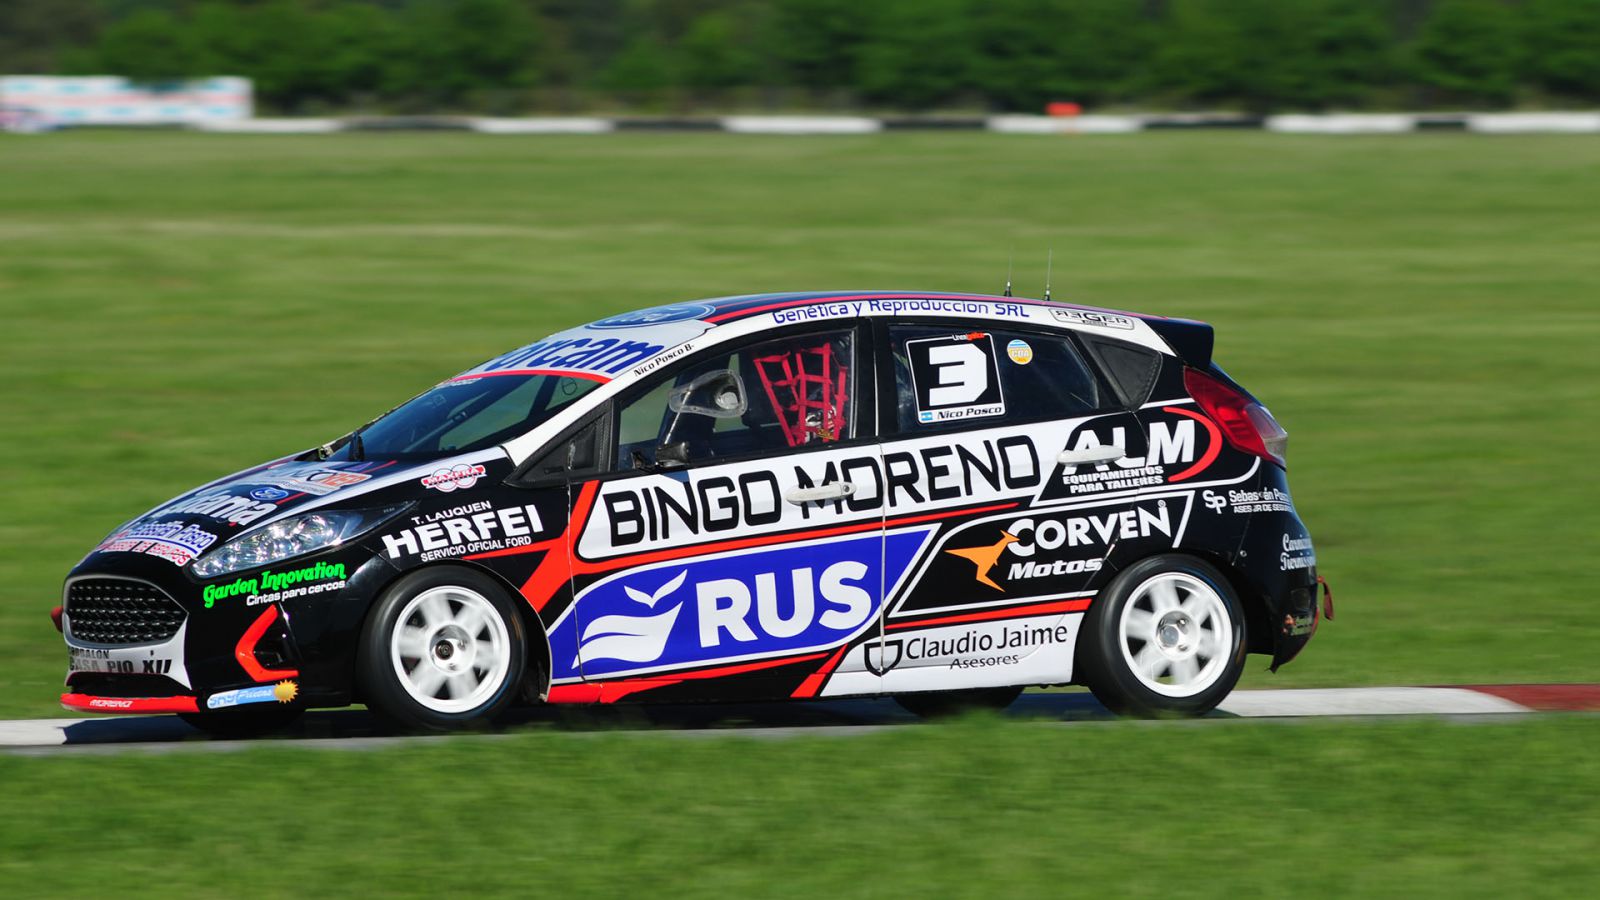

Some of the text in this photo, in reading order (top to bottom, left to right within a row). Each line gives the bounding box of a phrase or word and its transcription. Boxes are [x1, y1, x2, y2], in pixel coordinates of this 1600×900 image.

[772, 303, 850, 325] Genética
[853, 303, 863, 317] y
[994, 303, 1031, 318] SRL
[633, 362, 655, 376] Nico
[655, 348, 684, 365] Posco
[929, 343, 987, 407] 3
[937, 407, 1003, 420] Nico Posco
[1063, 420, 1195, 476] ALM
[1063, 465, 1164, 485] EQUIPAMIENTOS
[1070, 475, 1164, 493] PARA TALLERES
[603, 434, 1041, 547] BINGO MORENO
[411, 501, 492, 525] T. LAUQUEN
[382, 504, 544, 559] HERFEI
[1007, 507, 1171, 556] CORVEN
[421, 536, 532, 562] SERVICIO OFICIAL FORD
[1008, 557, 1103, 580] Motos
[203, 561, 346, 608] Garden Innovation
[246, 580, 346, 606] Cintas para cercos
[696, 561, 872, 648] RUS
[906, 624, 1067, 660] Claudio Jaime
[106, 660, 134, 674] PIO
[142, 659, 172, 674] XII
[949, 653, 1019, 670] Asesores
